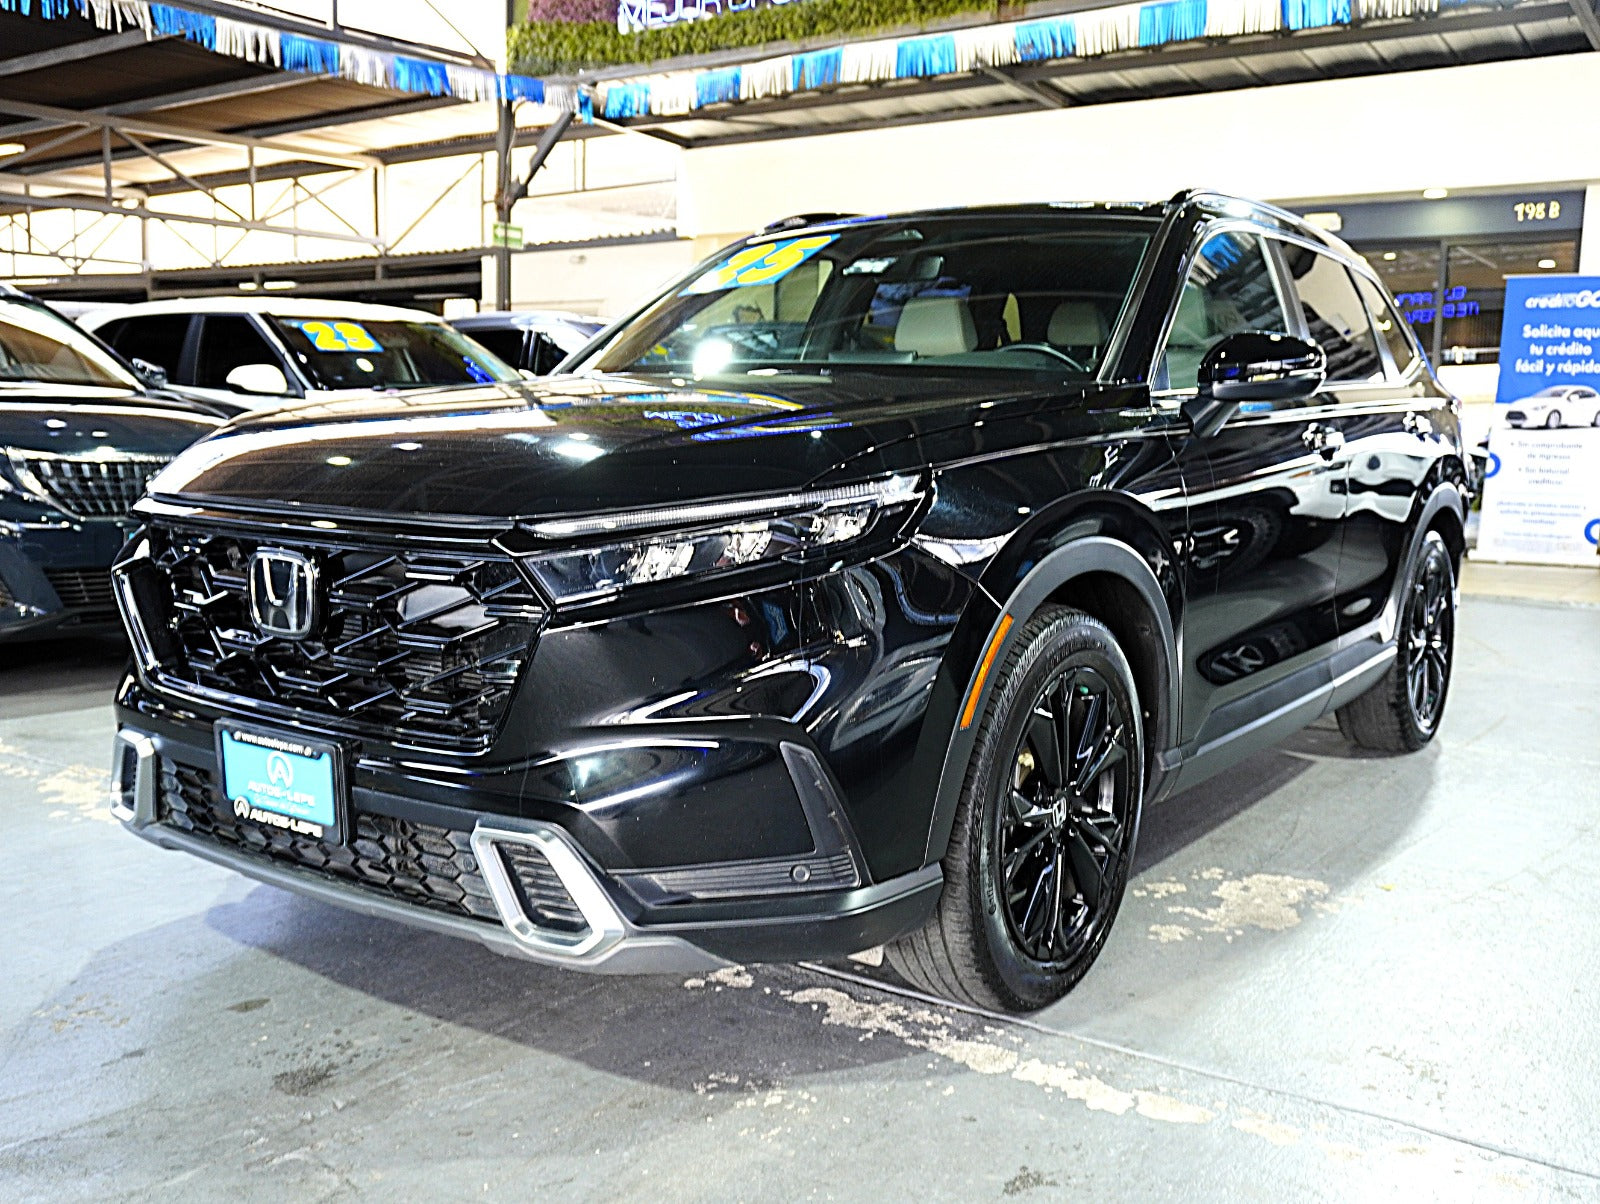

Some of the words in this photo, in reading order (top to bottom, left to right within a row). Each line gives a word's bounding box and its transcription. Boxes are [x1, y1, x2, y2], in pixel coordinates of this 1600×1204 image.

[1513, 202, 1546, 222] 198
[1549, 200, 1561, 219] B
[302, 322, 375, 350] 23
[1522, 324, 1571, 338] Solicita
[1573, 327, 1600, 341] aqu
[1529, 343, 1544, 355] tu
[1545, 341, 1593, 356] crédito
[1515, 358, 1544, 373] fácil
[1545, 362, 1555, 376] y
